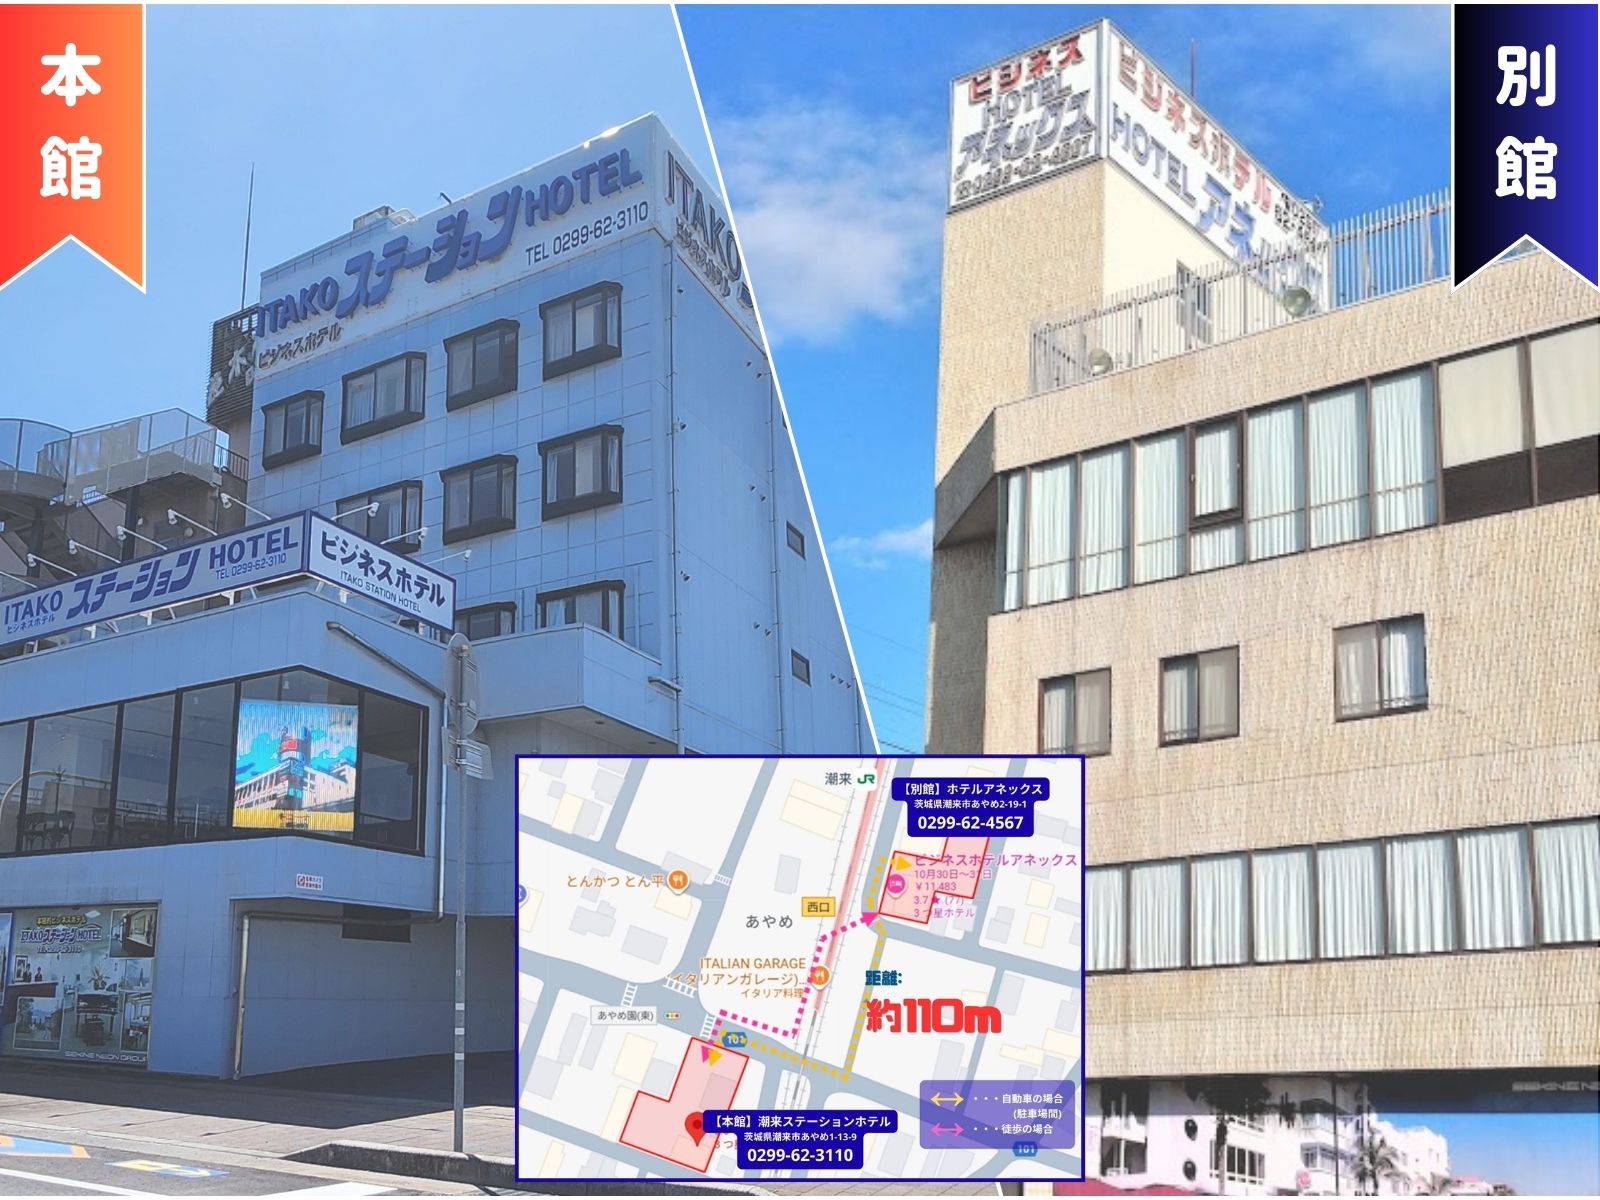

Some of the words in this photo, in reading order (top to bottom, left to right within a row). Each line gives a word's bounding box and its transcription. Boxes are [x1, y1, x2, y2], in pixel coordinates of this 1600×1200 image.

[968, 34, 1085, 106] ビジネス
[983, 72, 1073, 129] HOTEL
[953, 88, 1097, 182] アネックス
[1110, 102, 1197, 209] HOTEL
[1118, 40, 1272, 213] ビジネスホテル
[256, 276, 339, 337] ITAKO
[335, 184, 522, 319] ステーション
[525, 148, 643, 227] HOTEL
[526, 243, 549, 266] TEL
[553, 201, 648, 255] 0299-62-3110
[666, 150, 742, 282] ITAKO
[258, 321, 343, 369] ビジネスホテル
[4, 590, 63, 625] ITAKO
[66, 549, 201, 620] ステーション
[209, 527, 299, 570] HOTEL
[216, 568, 230, 580] TEL
[231, 553, 287, 577] 0299-62-3110
[321, 531, 446, 607] ビジネスホテル
[340, 570, 364, 588] ITAKO
[365, 582, 396, 602] STATION
[398, 597, 421, 613] HOTEL
[5, 614, 56, 634] ビジネスホテル
